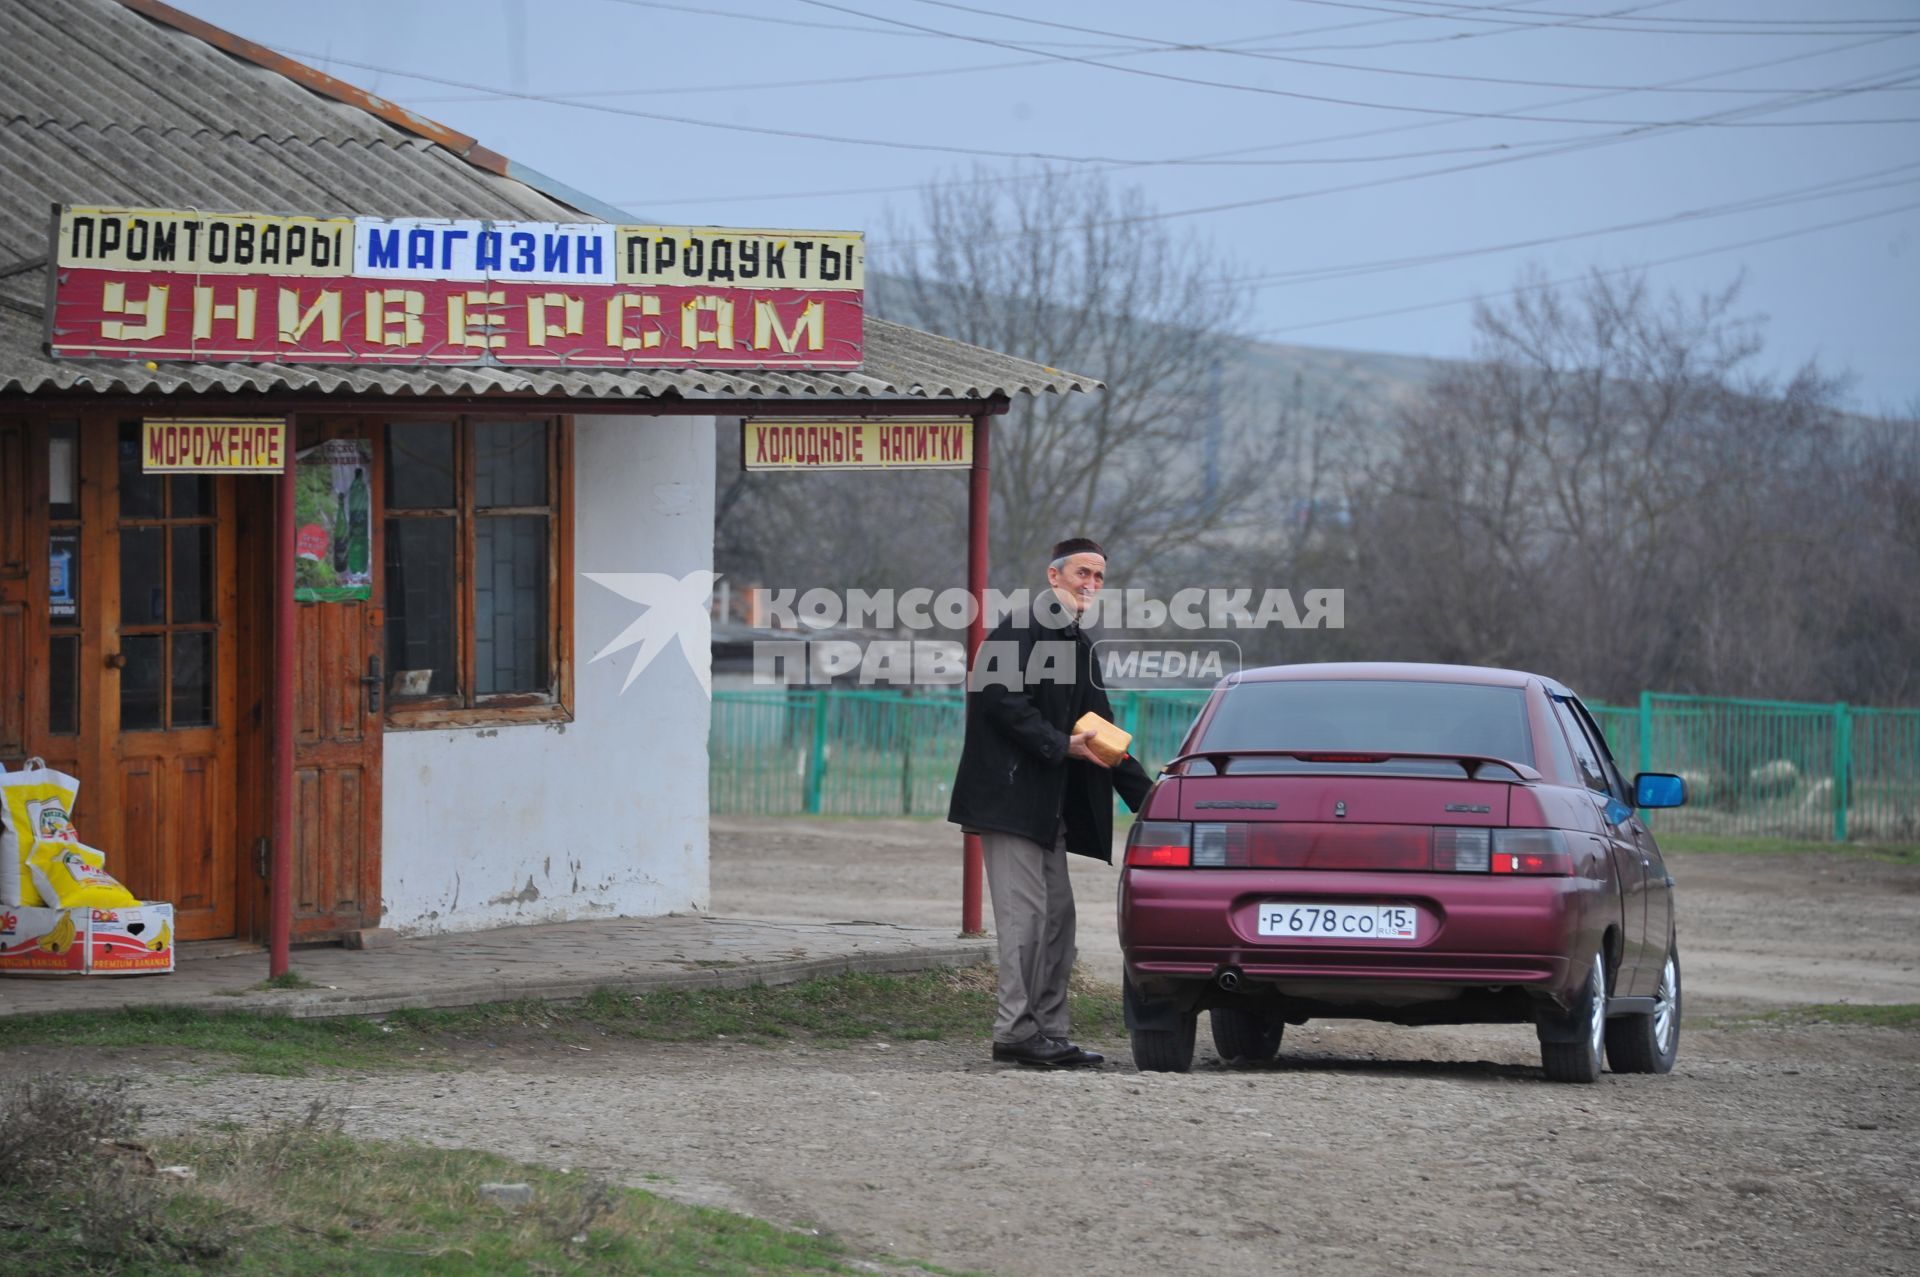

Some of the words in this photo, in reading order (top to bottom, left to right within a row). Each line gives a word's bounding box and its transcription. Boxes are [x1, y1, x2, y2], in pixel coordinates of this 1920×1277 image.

[71, 216, 342, 268] ПРОМТОВАРЫ
[367, 228, 603, 275] МАГАЗИН
[627, 235, 853, 282] ПРОДУКТЫ
[101, 280, 824, 354] УНИВЕРСАМ
[149, 426, 279, 466] МОРОЖЕНОЕ
[756, 426, 864, 465] ХОЛОДНЫЕ
[879, 425, 964, 463] НАПИТКИ
[1382, 910, 1406, 928] 15
